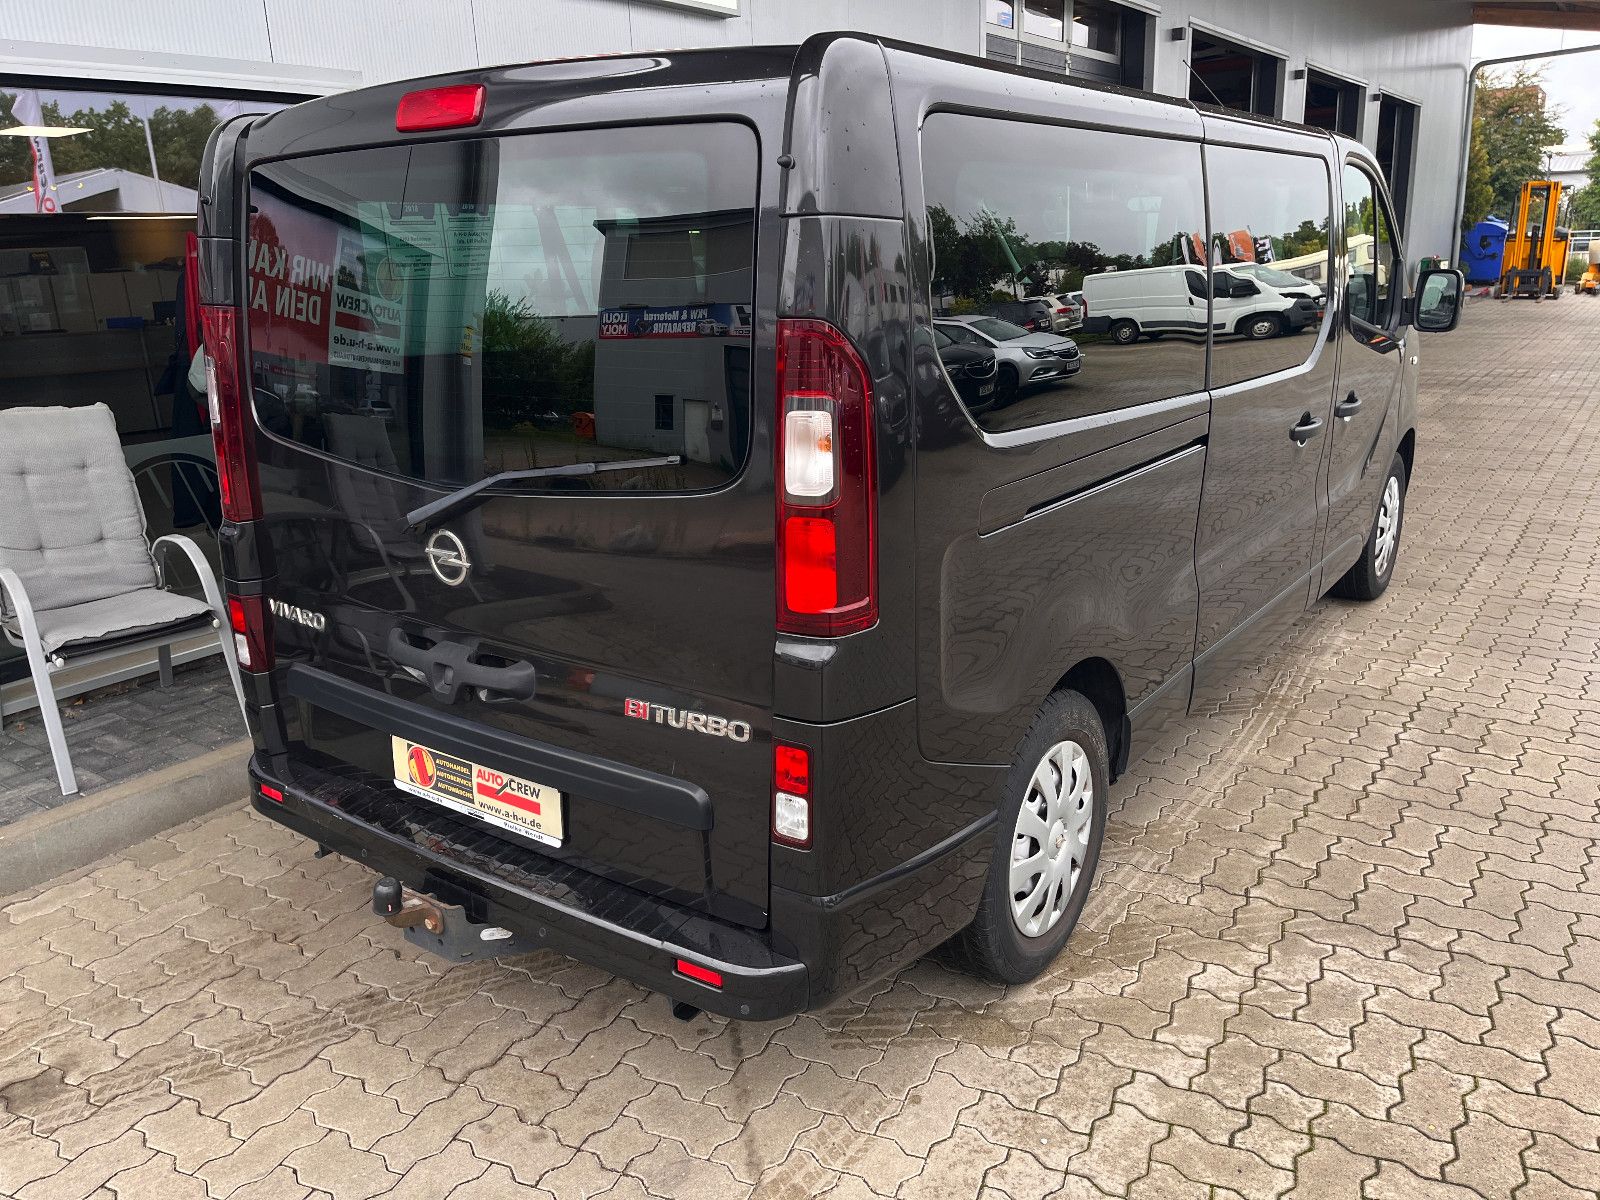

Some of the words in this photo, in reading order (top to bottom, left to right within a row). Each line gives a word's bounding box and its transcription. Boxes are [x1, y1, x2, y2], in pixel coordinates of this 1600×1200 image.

[267, 598, 326, 632] VIVARO
[435, 758, 471, 775] AUTOHANDEL
[436, 770, 473, 788] AUTOSERVICE
[476, 768, 504, 787] AUTO
[508, 779, 541, 800] CREW
[478, 801, 542, 830] www.a-h-u.de
